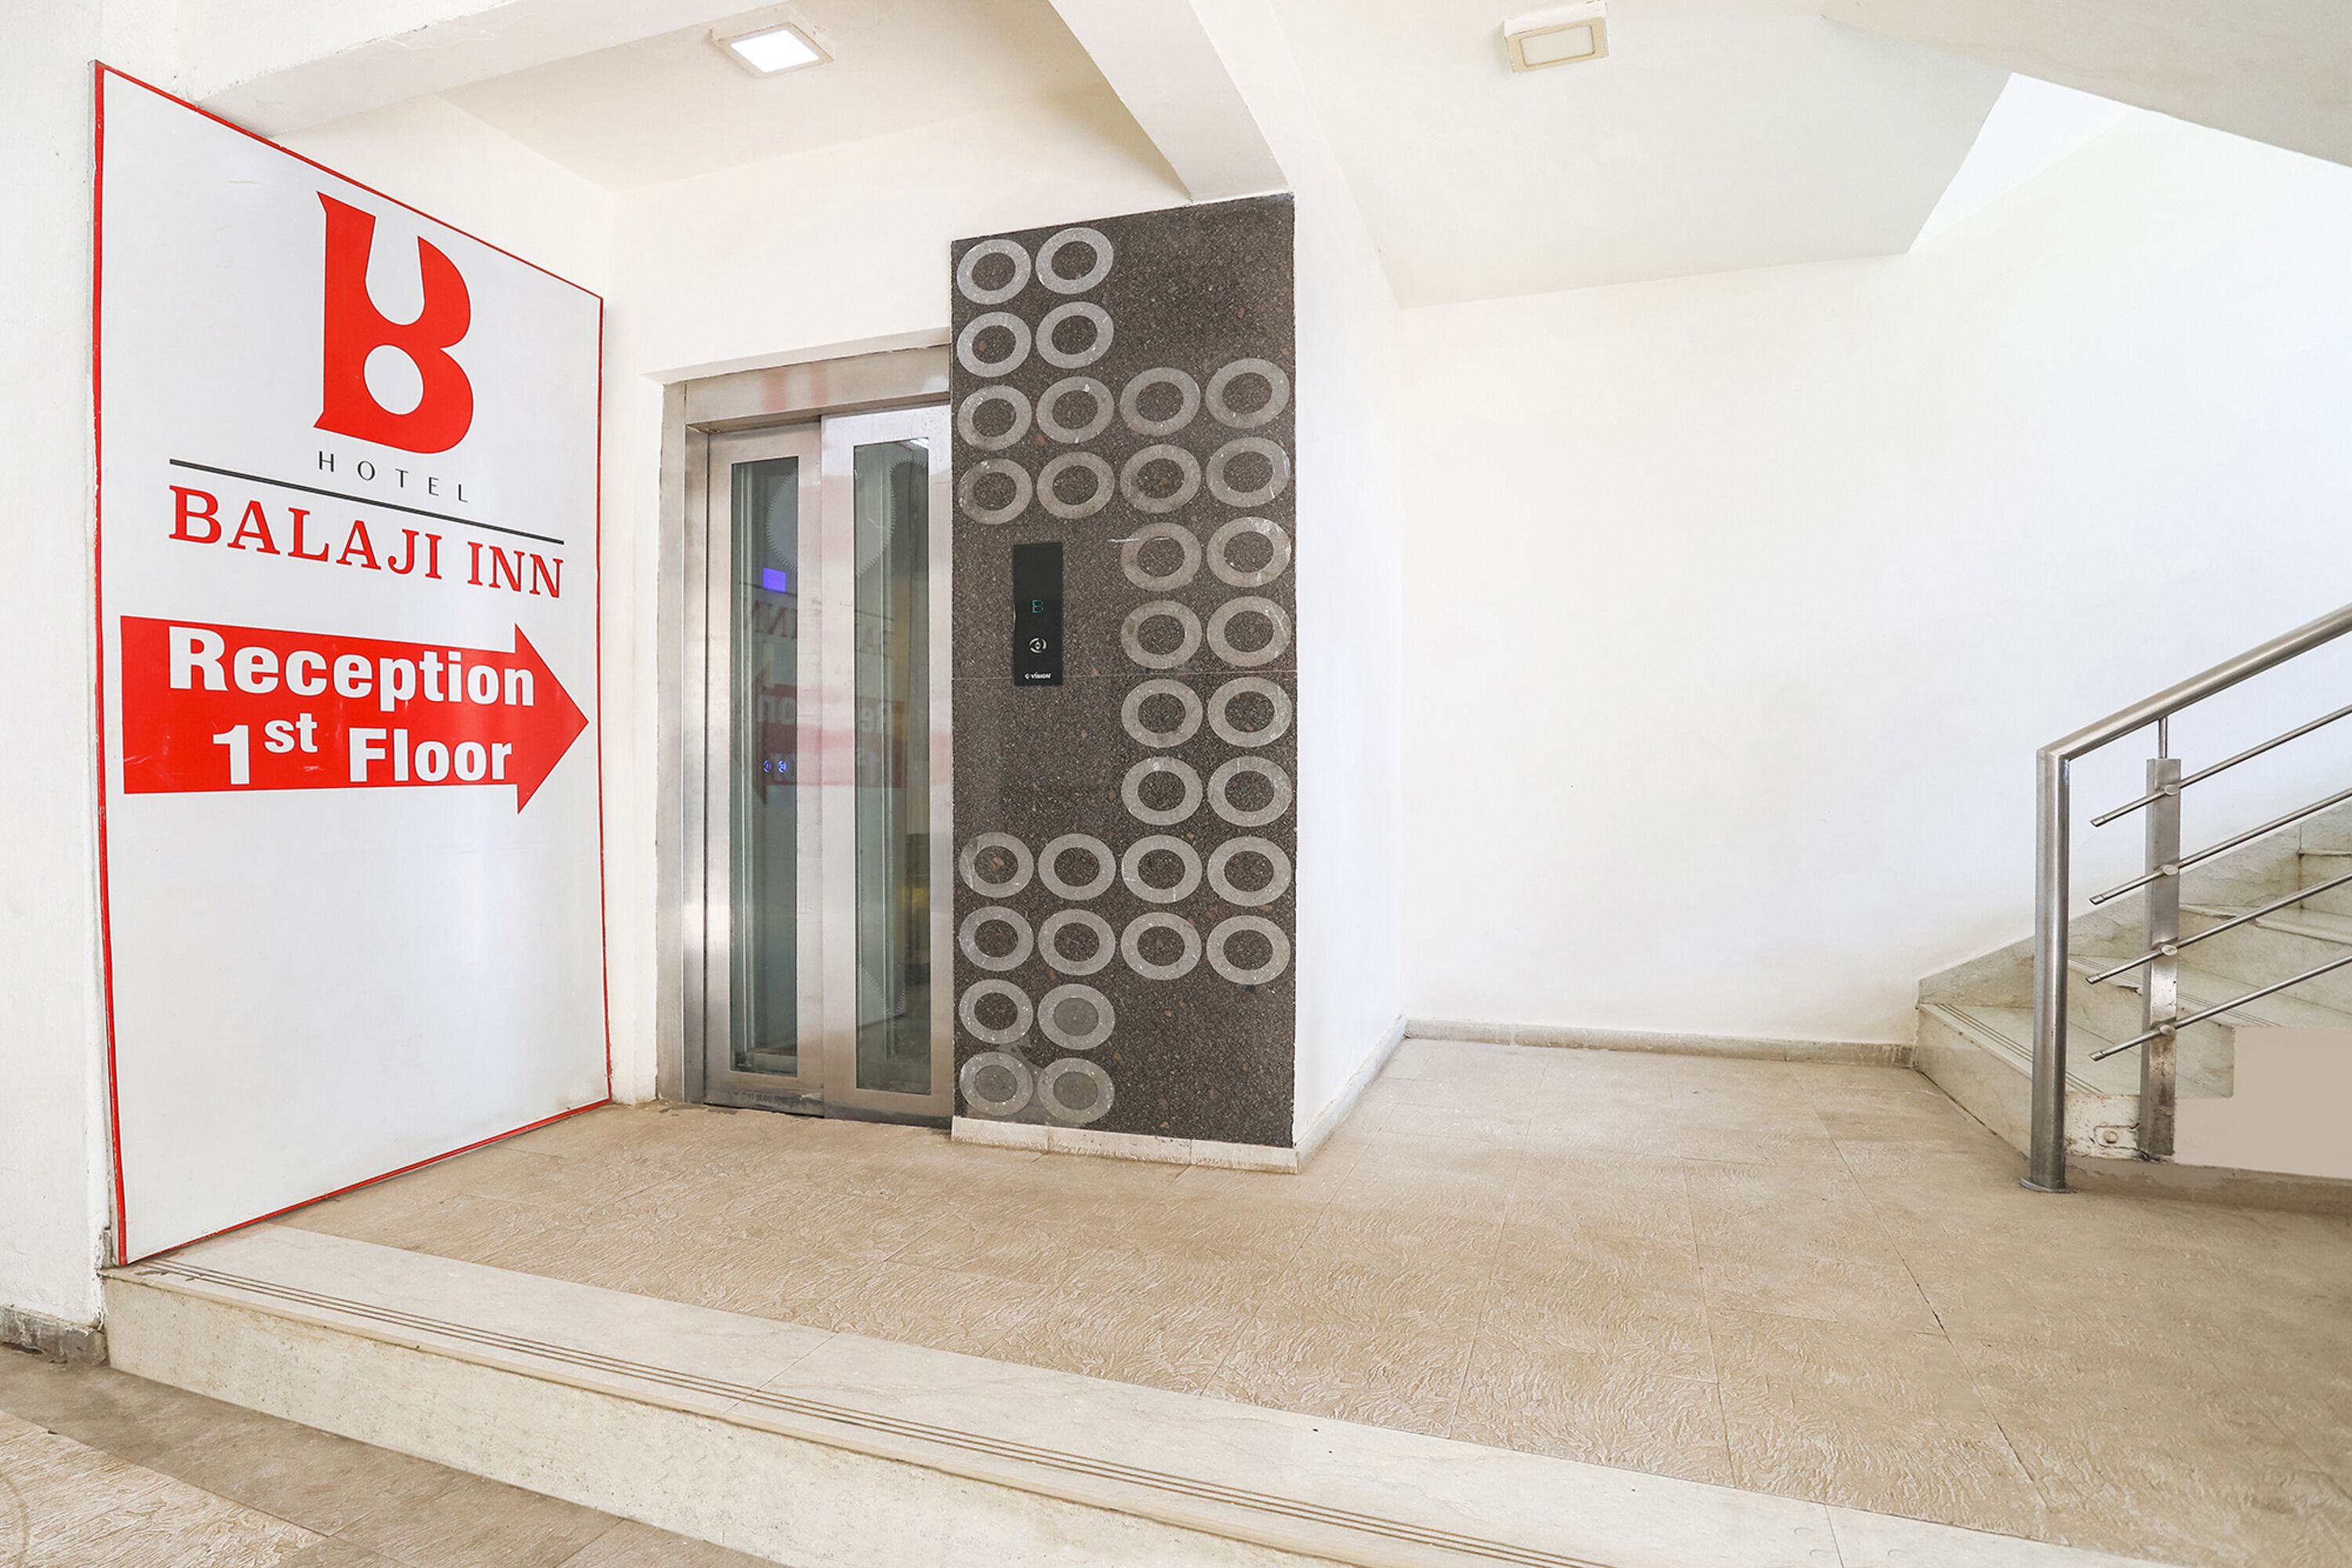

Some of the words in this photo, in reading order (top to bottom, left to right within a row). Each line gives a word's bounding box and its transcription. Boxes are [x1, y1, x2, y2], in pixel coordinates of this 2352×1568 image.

[318, 450, 469, 503] HOTEL
[168, 484, 443, 579] BALAJI
[467, 541, 564, 598] INN
[1032, 599, 1044, 613] B
[168, 626, 535, 713] Reception
[212, 713, 318, 785] 1st
[349, 728, 513, 782] Floor
